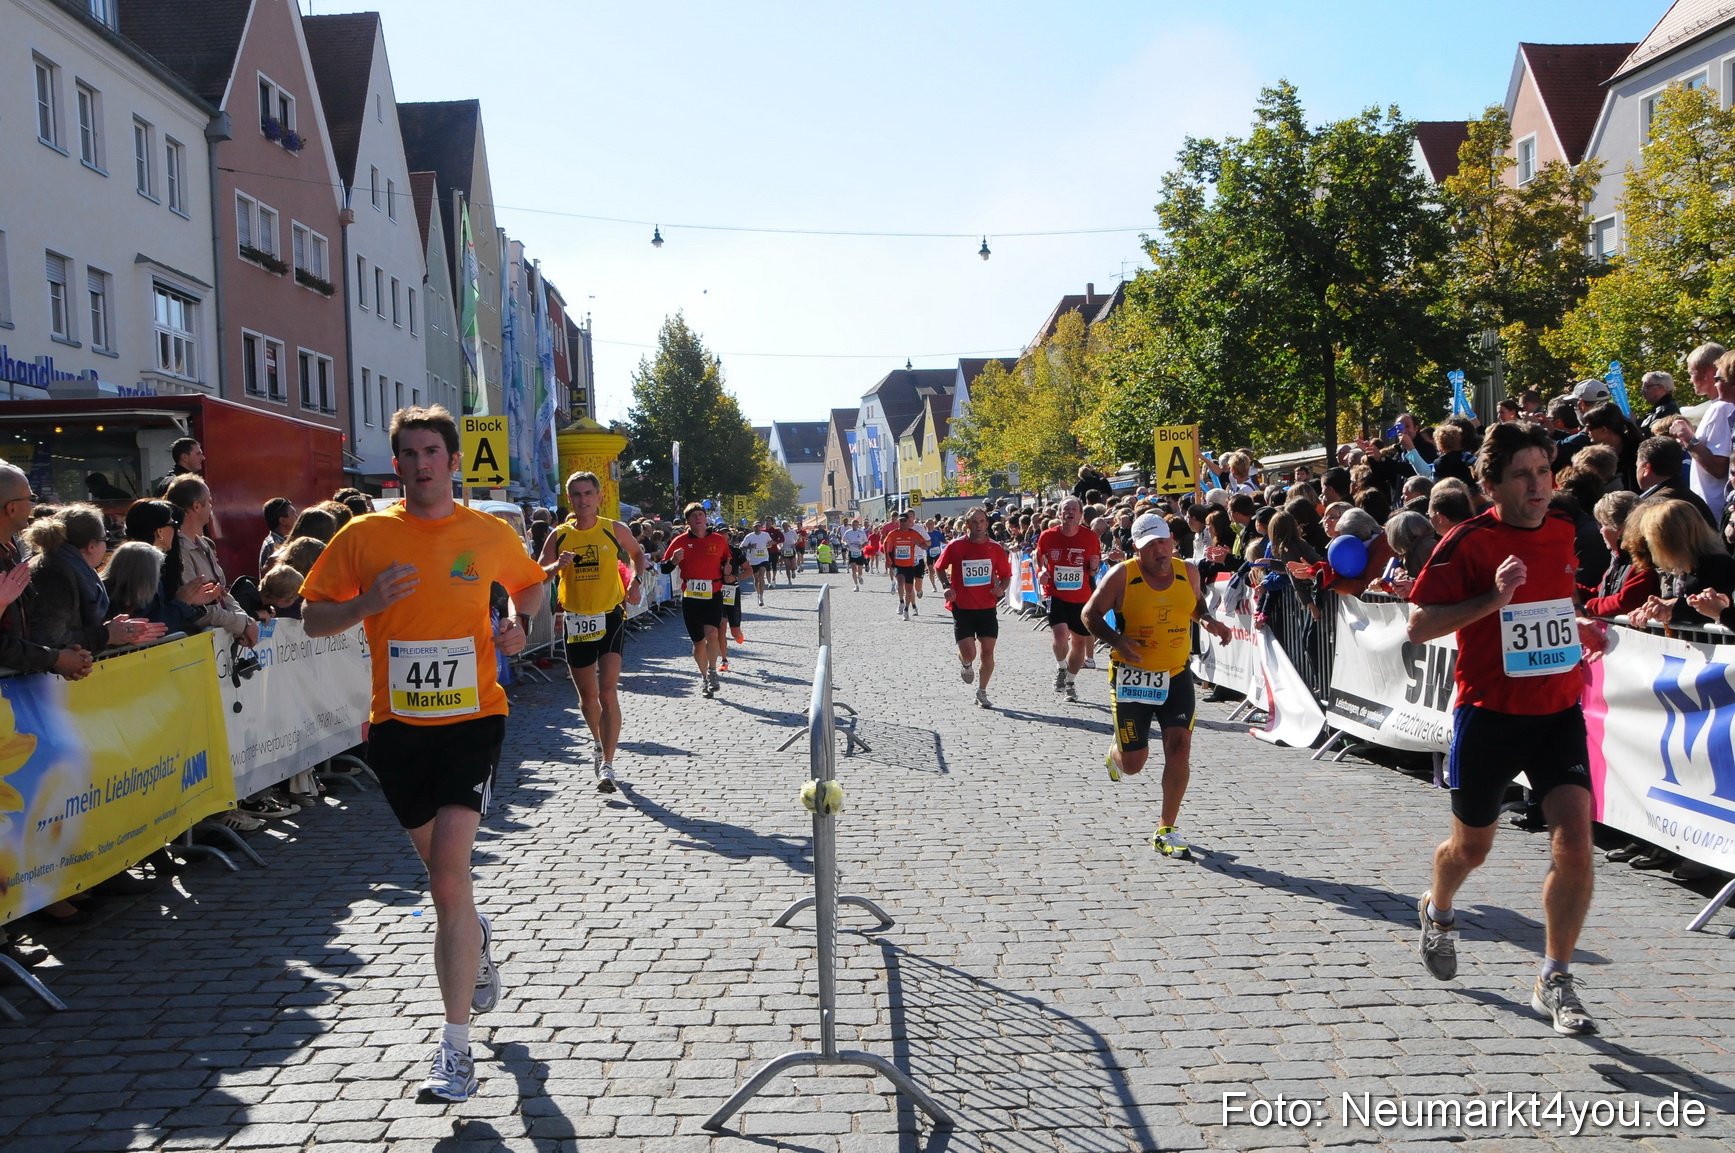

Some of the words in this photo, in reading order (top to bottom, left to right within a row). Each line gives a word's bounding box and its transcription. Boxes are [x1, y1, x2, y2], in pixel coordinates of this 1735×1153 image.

[465, 419, 503, 432] Block
[1159, 429, 1194, 442] Block
[472, 437, 499, 472] A
[1165, 446, 1191, 479] A
[737, 500, 744, 509] B
[913, 494, 919, 503] B
[574, 566, 600, 574] HIRSCH
[965, 566, 989, 577] 3509
[1056, 572, 1080, 582] 3488
[691, 581, 707, 591] 140
[1513, 607, 1548, 617] PFLEIDERER
[574, 619, 597, 634] 196
[1512, 618, 1572, 651] 3105
[400, 647, 438, 655] PFLEIDERER
[1528, 651, 1566, 667] Klaus
[406, 660, 459, 689] 447
[1122, 669, 1164, 688] 2313
[406, 691, 462, 707] Markus
[1121, 686, 1162, 699] Pasquale
[1392, 711, 1444, 745] stadtwerke
[1645, 810, 1678, 838] MICRO
[1683, 825, 1735, 855] COMPU
[60, 850, 95, 869] Palisaden
